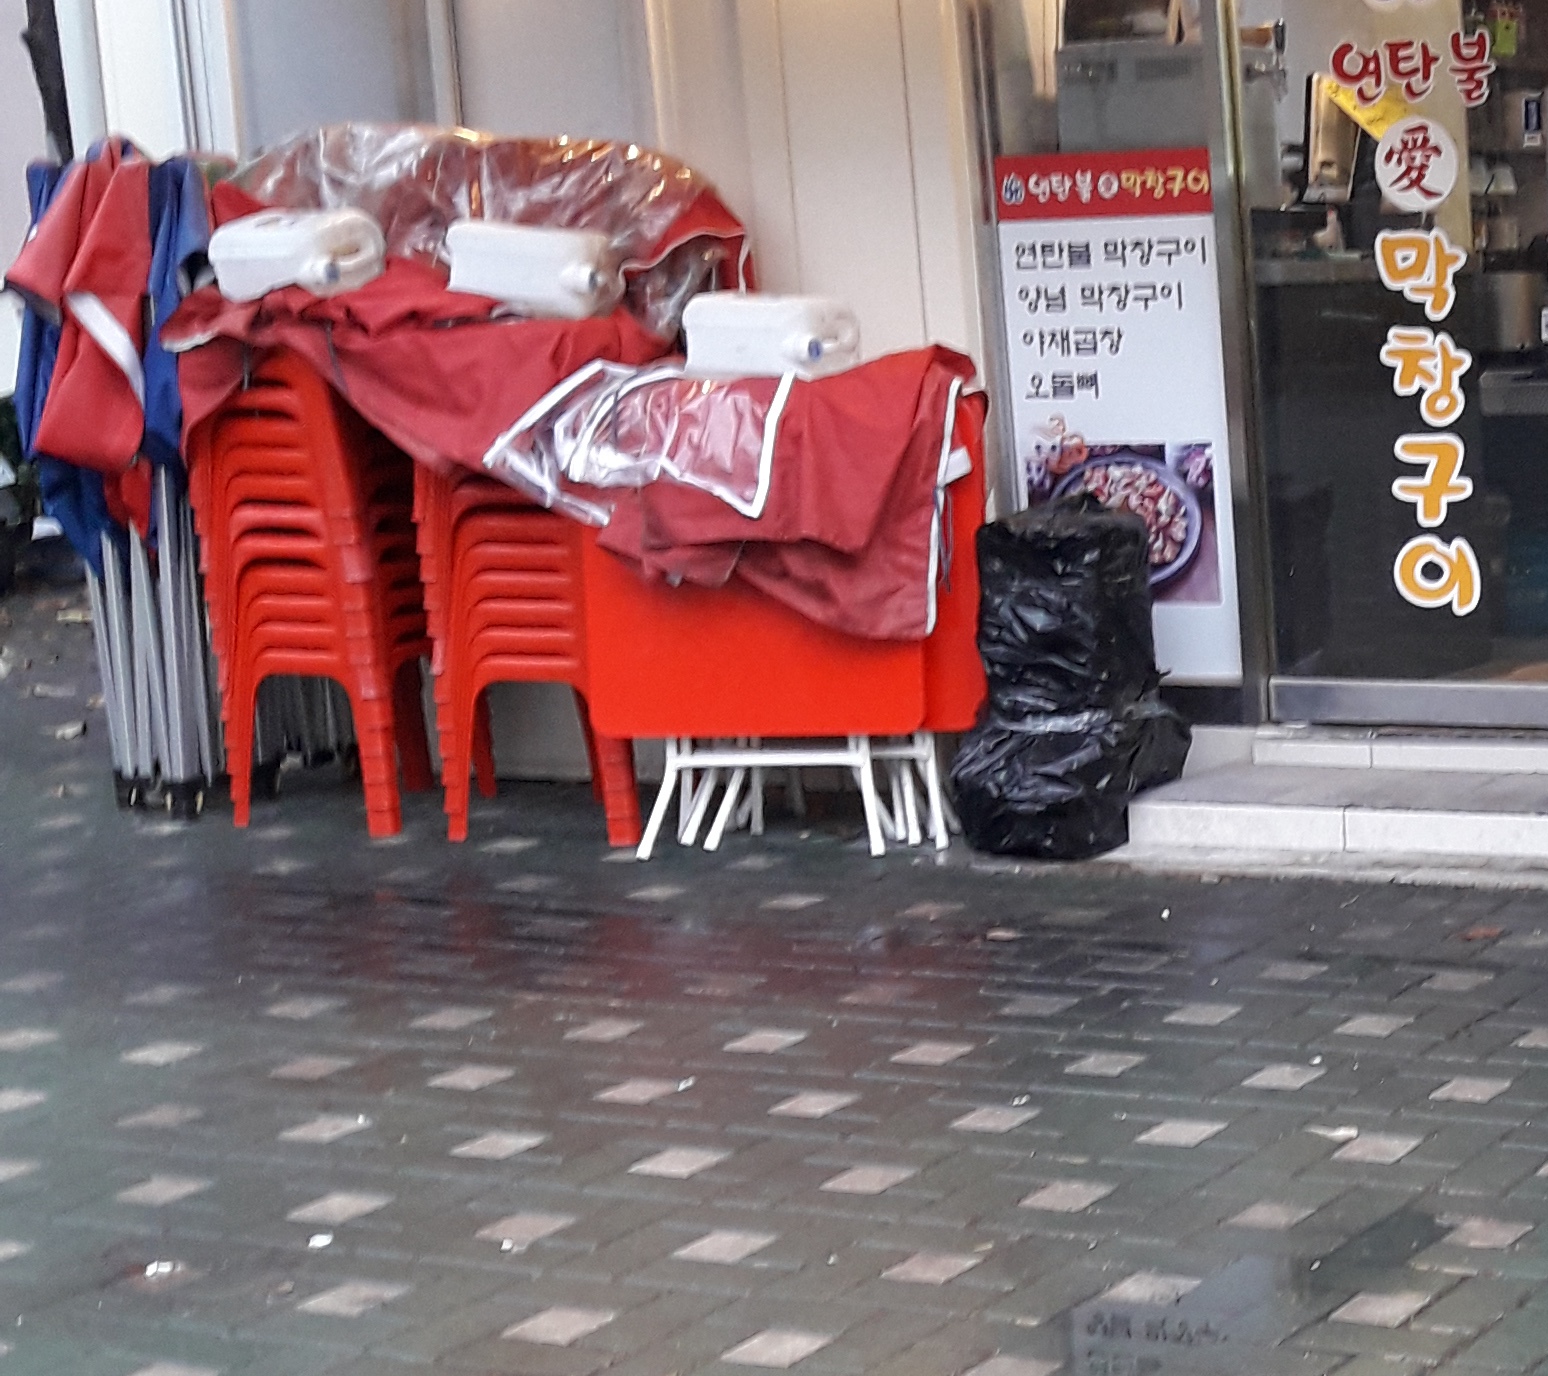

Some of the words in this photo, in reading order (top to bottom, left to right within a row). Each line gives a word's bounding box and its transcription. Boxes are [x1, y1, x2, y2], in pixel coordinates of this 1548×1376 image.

[1328, 28, 1495, 109] 연탄불
[1383, 124, 1445, 203] 愛
[1373, 228, 1482, 618] 막창구이
